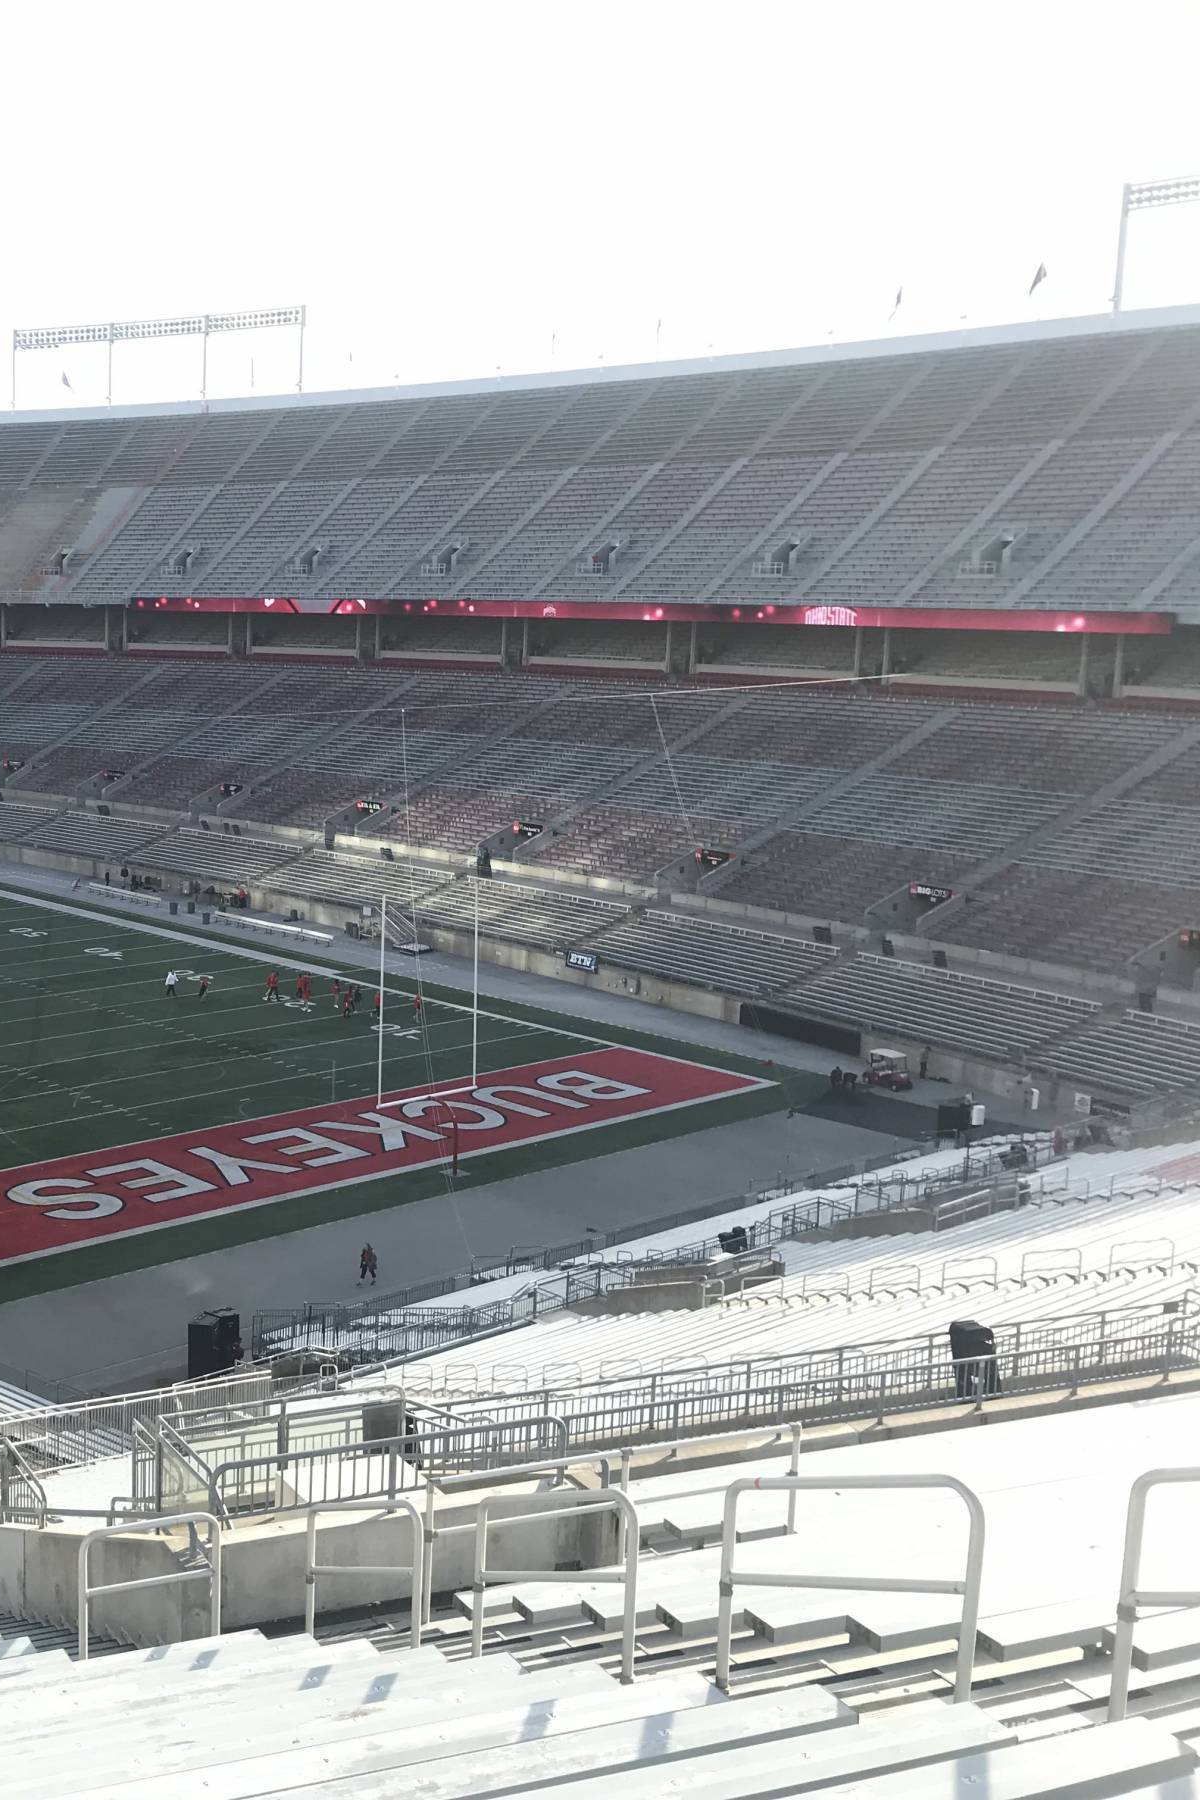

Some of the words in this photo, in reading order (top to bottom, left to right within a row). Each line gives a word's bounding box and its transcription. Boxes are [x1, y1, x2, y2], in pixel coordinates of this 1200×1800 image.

[827, 606, 858, 627] STATE
[8, 927, 48, 938] 50
[84, 947, 124, 960] 40
[569, 953, 592, 967] BTN
[370, 1023, 421, 1040] 10
[4, 1070, 653, 1221] BUCKEYES
